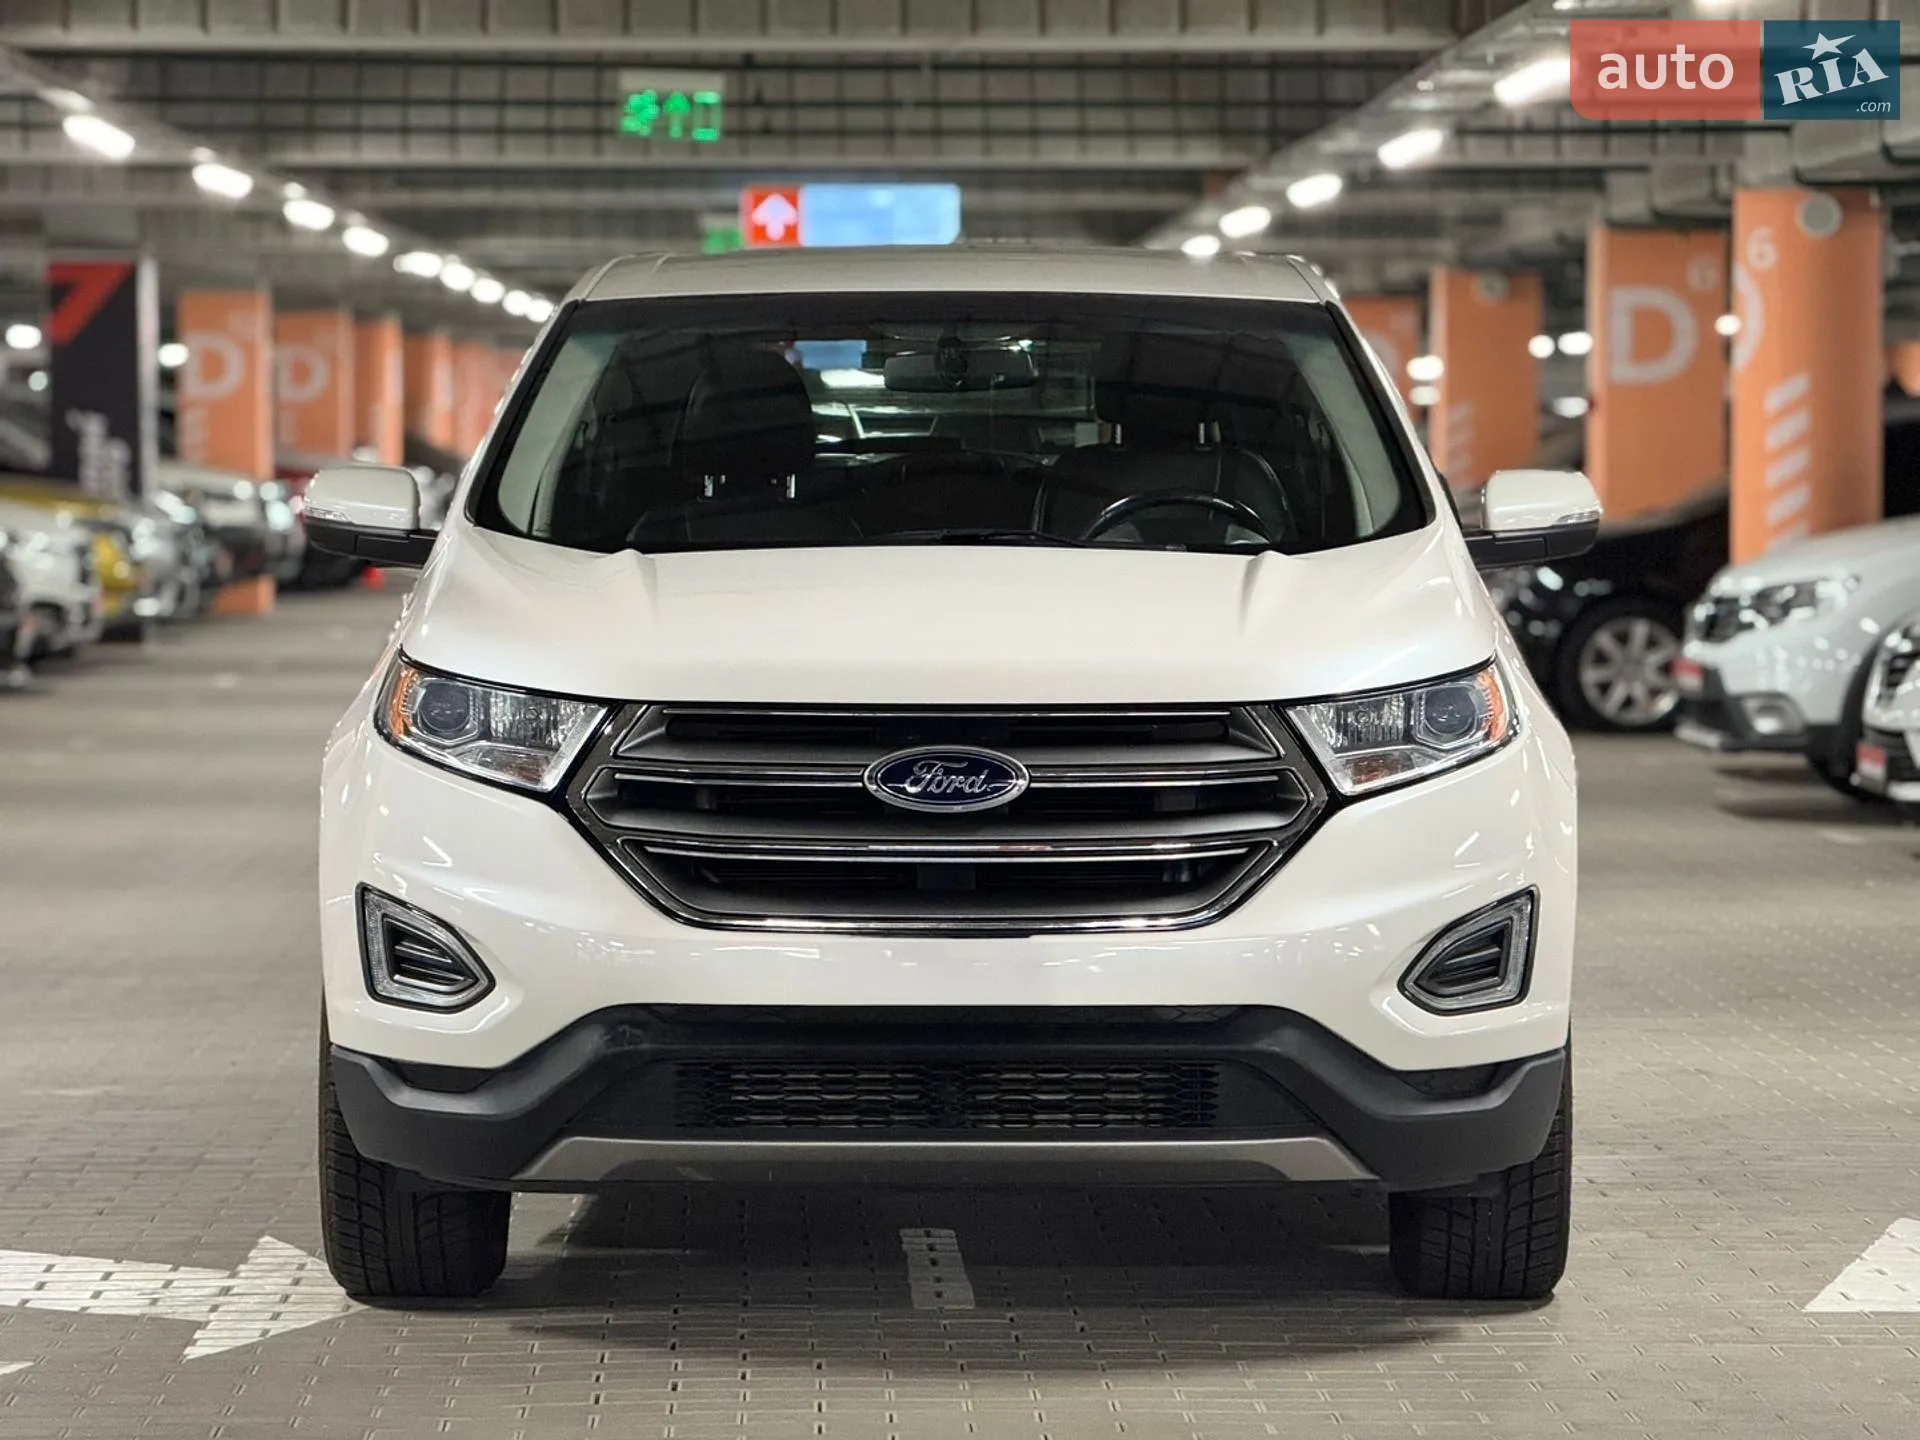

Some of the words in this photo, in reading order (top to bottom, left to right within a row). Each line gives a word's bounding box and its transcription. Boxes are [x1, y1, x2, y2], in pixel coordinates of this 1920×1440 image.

[181, 330, 245, 399] D
[1611, 285, 1699, 383] D
[904, 760, 992, 794] Ford
